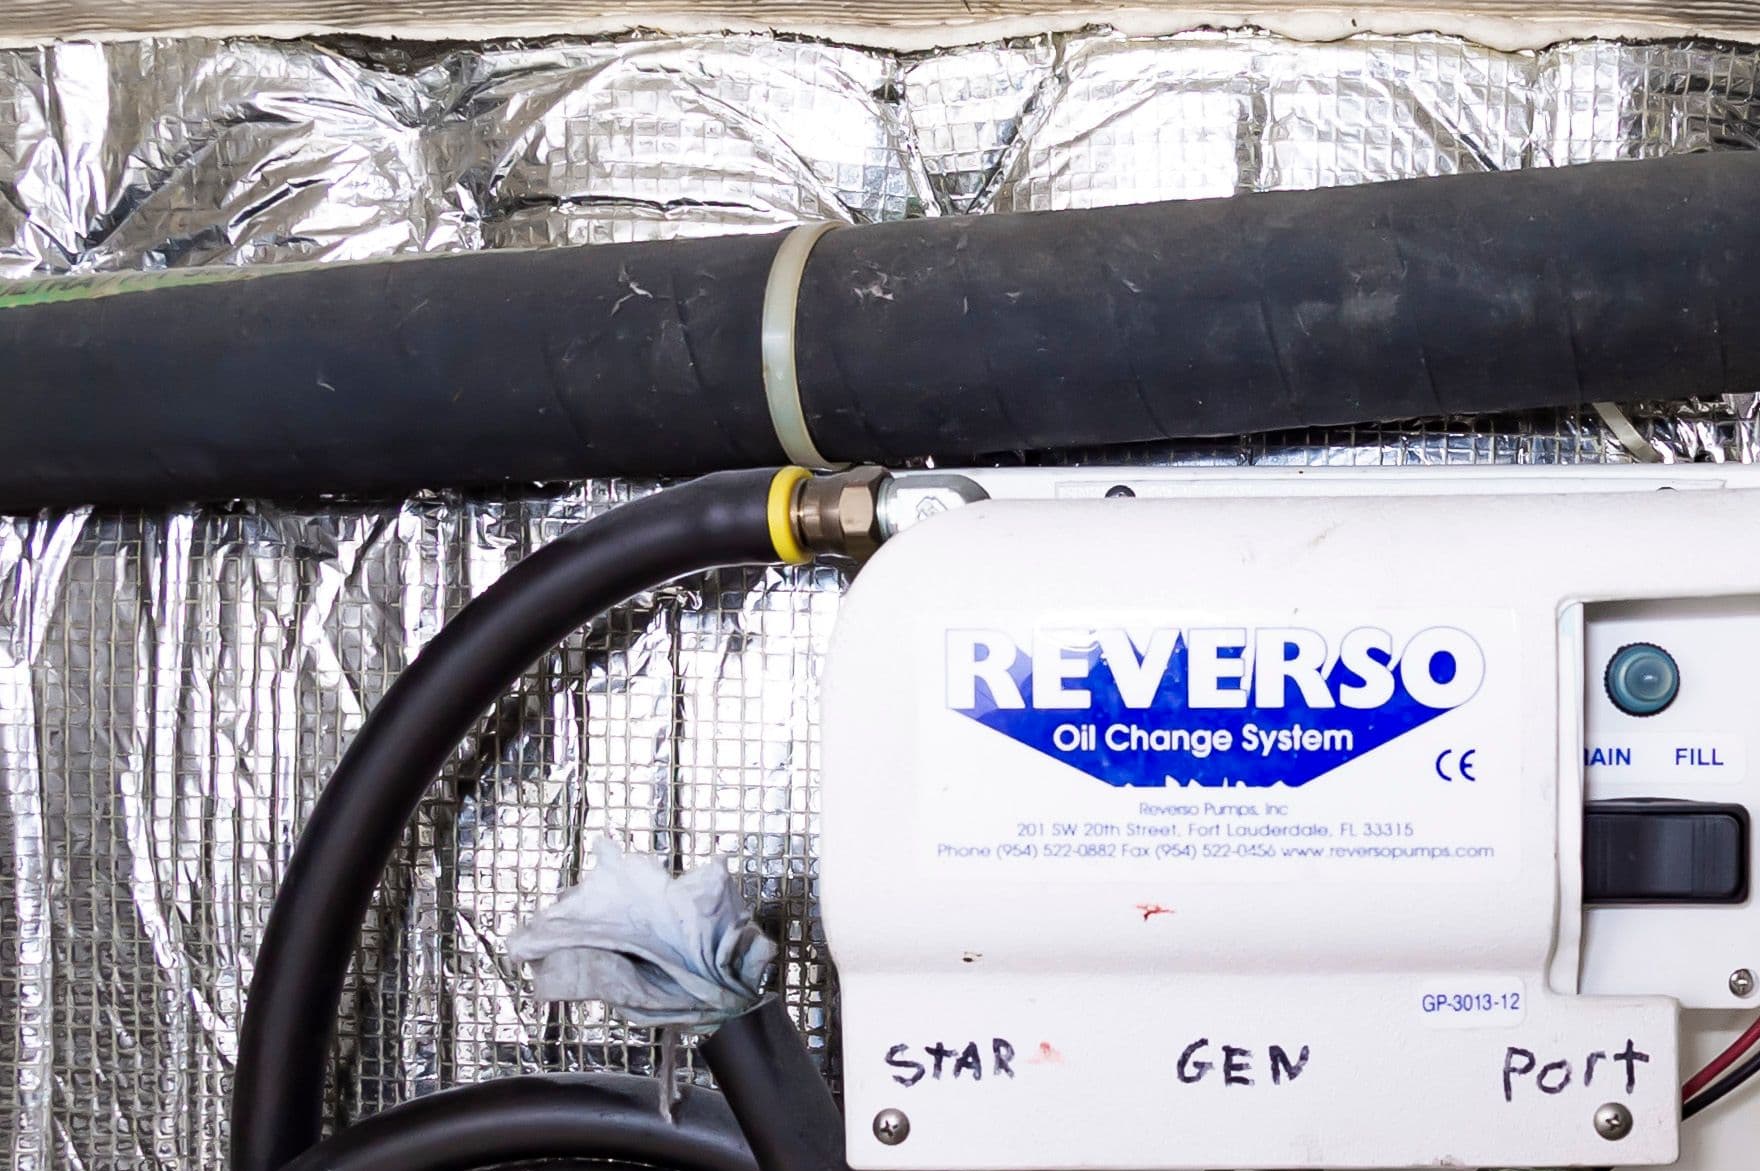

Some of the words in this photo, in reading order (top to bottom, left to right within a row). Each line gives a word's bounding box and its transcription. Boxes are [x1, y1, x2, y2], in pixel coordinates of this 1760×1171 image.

[945, 625, 1487, 710] REVERSO
[1053, 723, 1096, 752] Oil
[1105, 723, 1233, 757] Change
[1241, 725, 1353, 757] System
[1675, 748, 1724, 766] FILL
[1139, 802, 1199, 816] Reverso
[1017, 823, 1044, 837] 201
[1052, 823, 1077, 837] SW
[1084, 823, 1120, 837] 20th
[1188, 823, 1220, 837] Fort
[1340, 823, 1357, 837] FL
[1363, 823, 1414, 837] 33315
[937, 843, 991, 857] Phone
[996, 843, 1038, 860] (954)
[1043, 843, 1116, 857] 522-0882
[1121, 843, 1150, 857] Fax
[1155, 843, 1197, 860] (954)
[1422, 992, 1520, 1012] GP-3013-12
[1176, 1037, 1310, 1086] GEN
